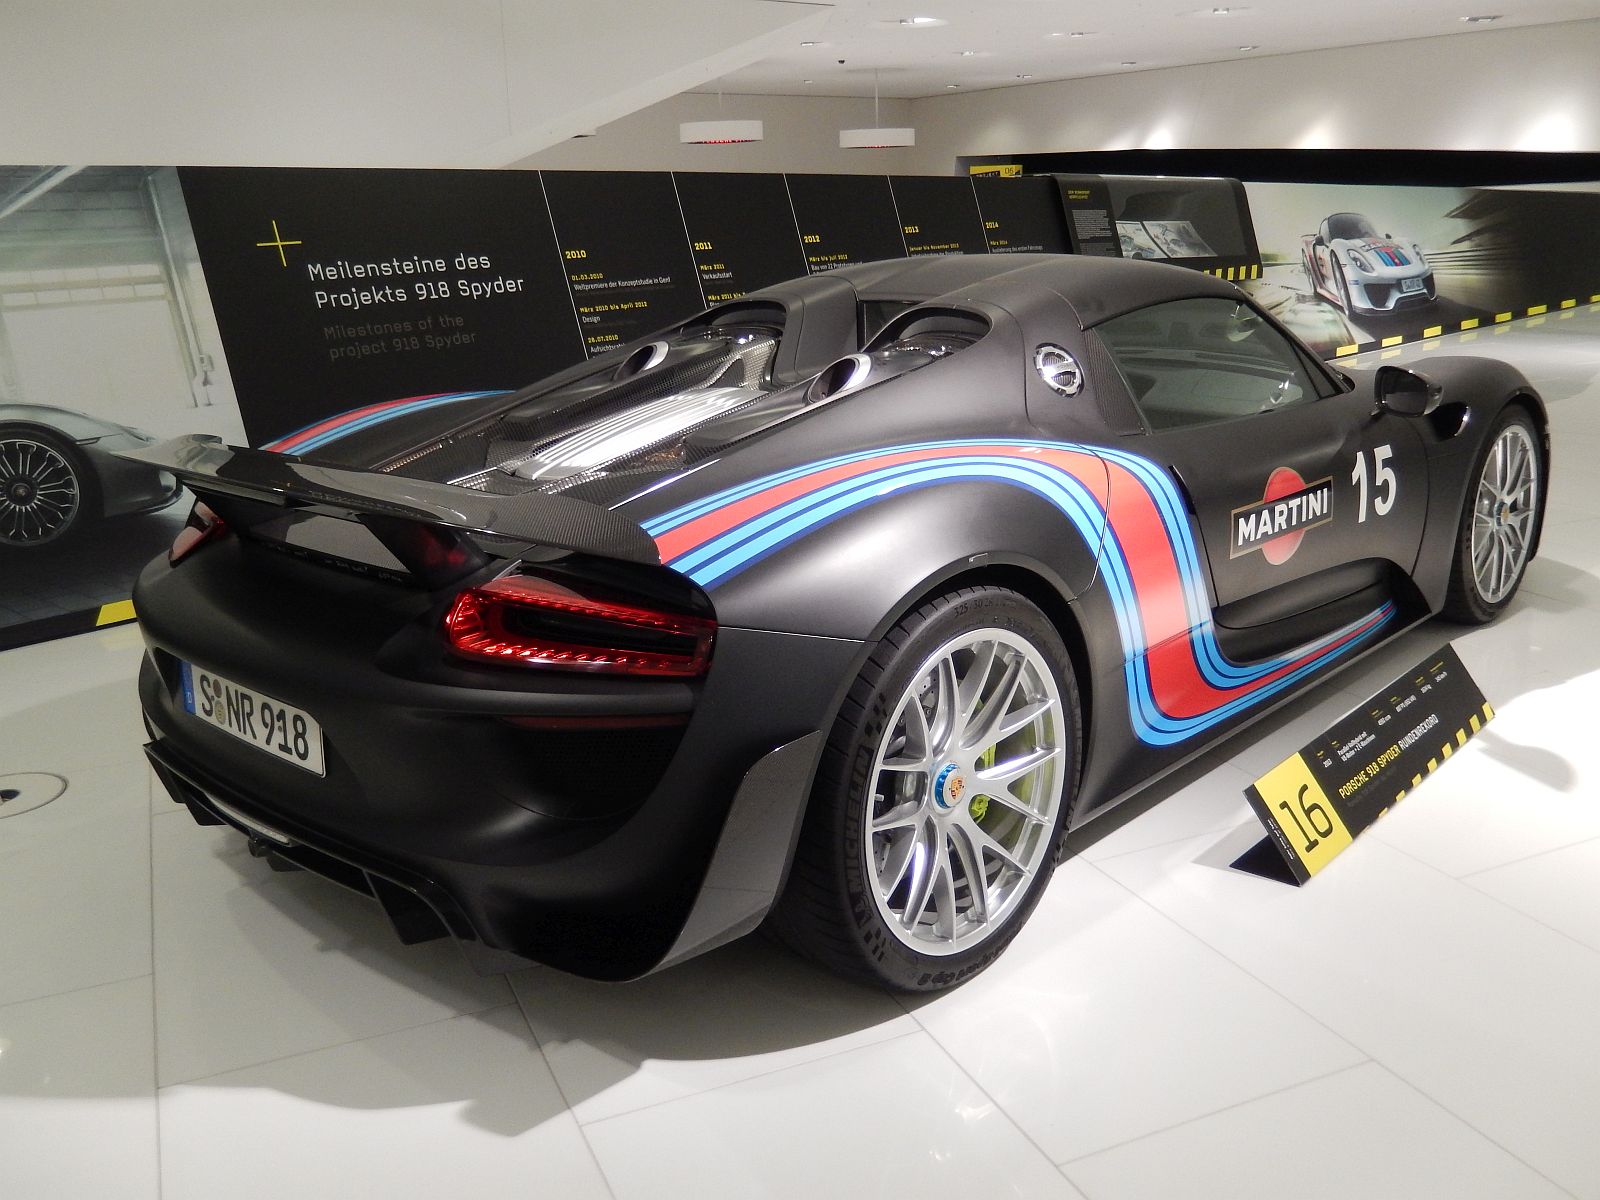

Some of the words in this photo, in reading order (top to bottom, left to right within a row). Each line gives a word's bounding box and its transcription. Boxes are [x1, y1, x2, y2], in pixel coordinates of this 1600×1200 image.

[803, 235, 821, 243] 2012
[985, 221, 999, 229] 2014
[565, 249, 587, 259] 2010
[694, 241, 713, 251] 2011
[307, 254, 447, 281] Meilensteine
[454, 252, 491, 270] des
[571, 272, 604, 281] 01.03.2010
[315, 285, 407, 310] Projekts
[414, 281, 450, 300] 918
[458, 276, 525, 300] Spyder
[573, 281, 608, 291] Weltpremiere
[608, 280, 618, 288] der
[323, 320, 413, 341] Milestones
[418, 316, 433, 331] of
[438, 313, 464, 329] the
[581, 315, 601, 325] Design
[329, 340, 388, 362] project
[392, 336, 420, 352] 918
[426, 330, 478, 352] Spyder
[1352, 444, 1397, 523] 15
[1237, 487, 1328, 546] MARTINI
[200, 674, 213, 718] S
[225, 685, 257, 740] NR
[260, 702, 309, 761] 918
[1338, 770, 1369, 799] PORSCHE
[1366, 761, 1380, 778] 918
[1377, 744, 1401, 768] SPYDER
[1398, 713, 1439, 751] RUNDENREKORD
[1279, 783, 1334, 853] 16
